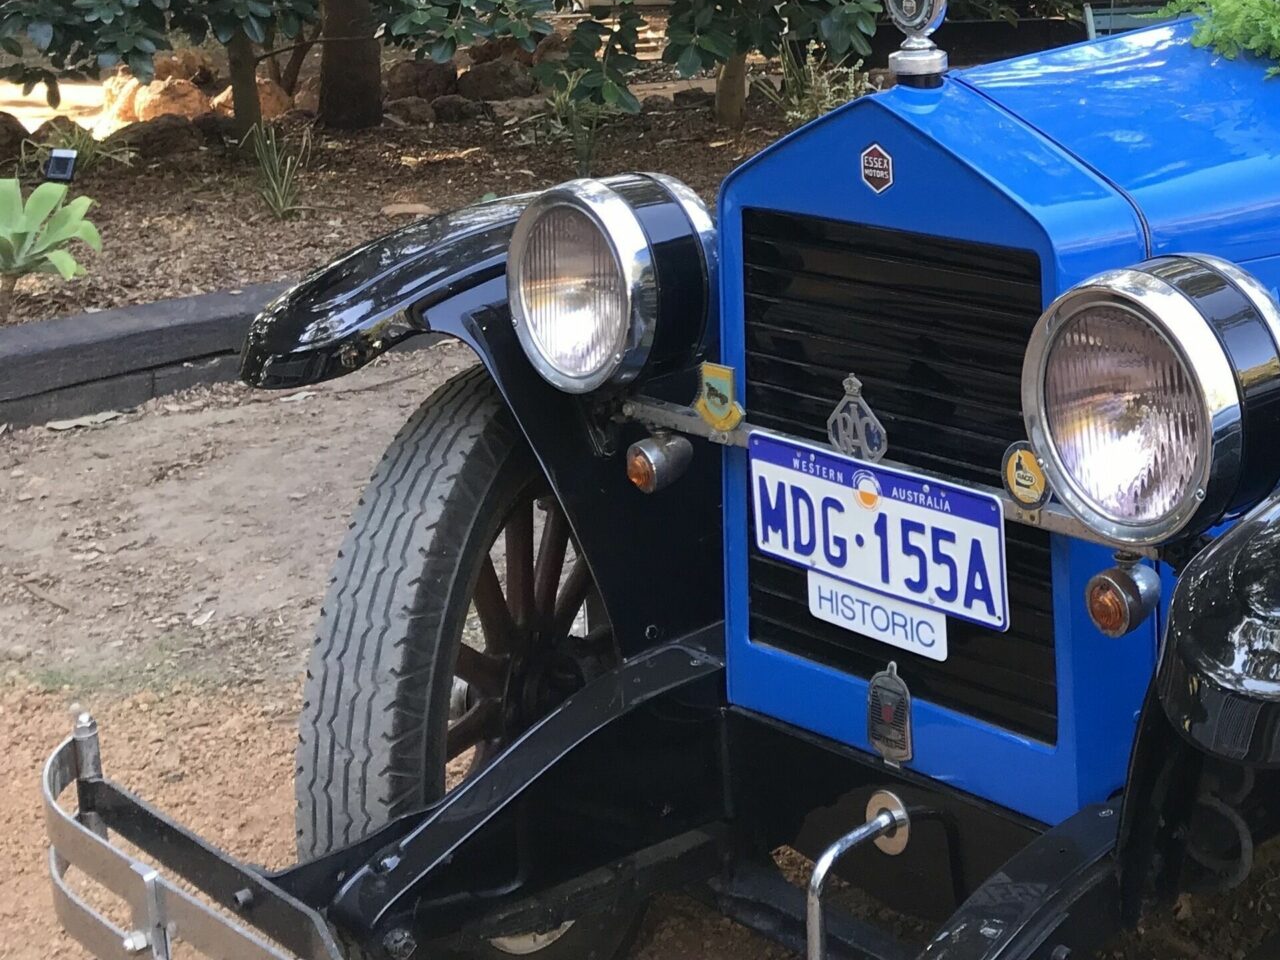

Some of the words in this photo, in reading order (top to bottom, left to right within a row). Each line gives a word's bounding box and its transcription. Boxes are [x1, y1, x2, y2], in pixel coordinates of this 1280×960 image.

[864, 156, 889, 169] ESSEX
[865, 169, 889, 179] MOTORS
[792, 458, 844, 483] WESTERN
[891, 487, 951, 512] AUSTRALIA
[817, 585, 935, 648] HISTORIC
